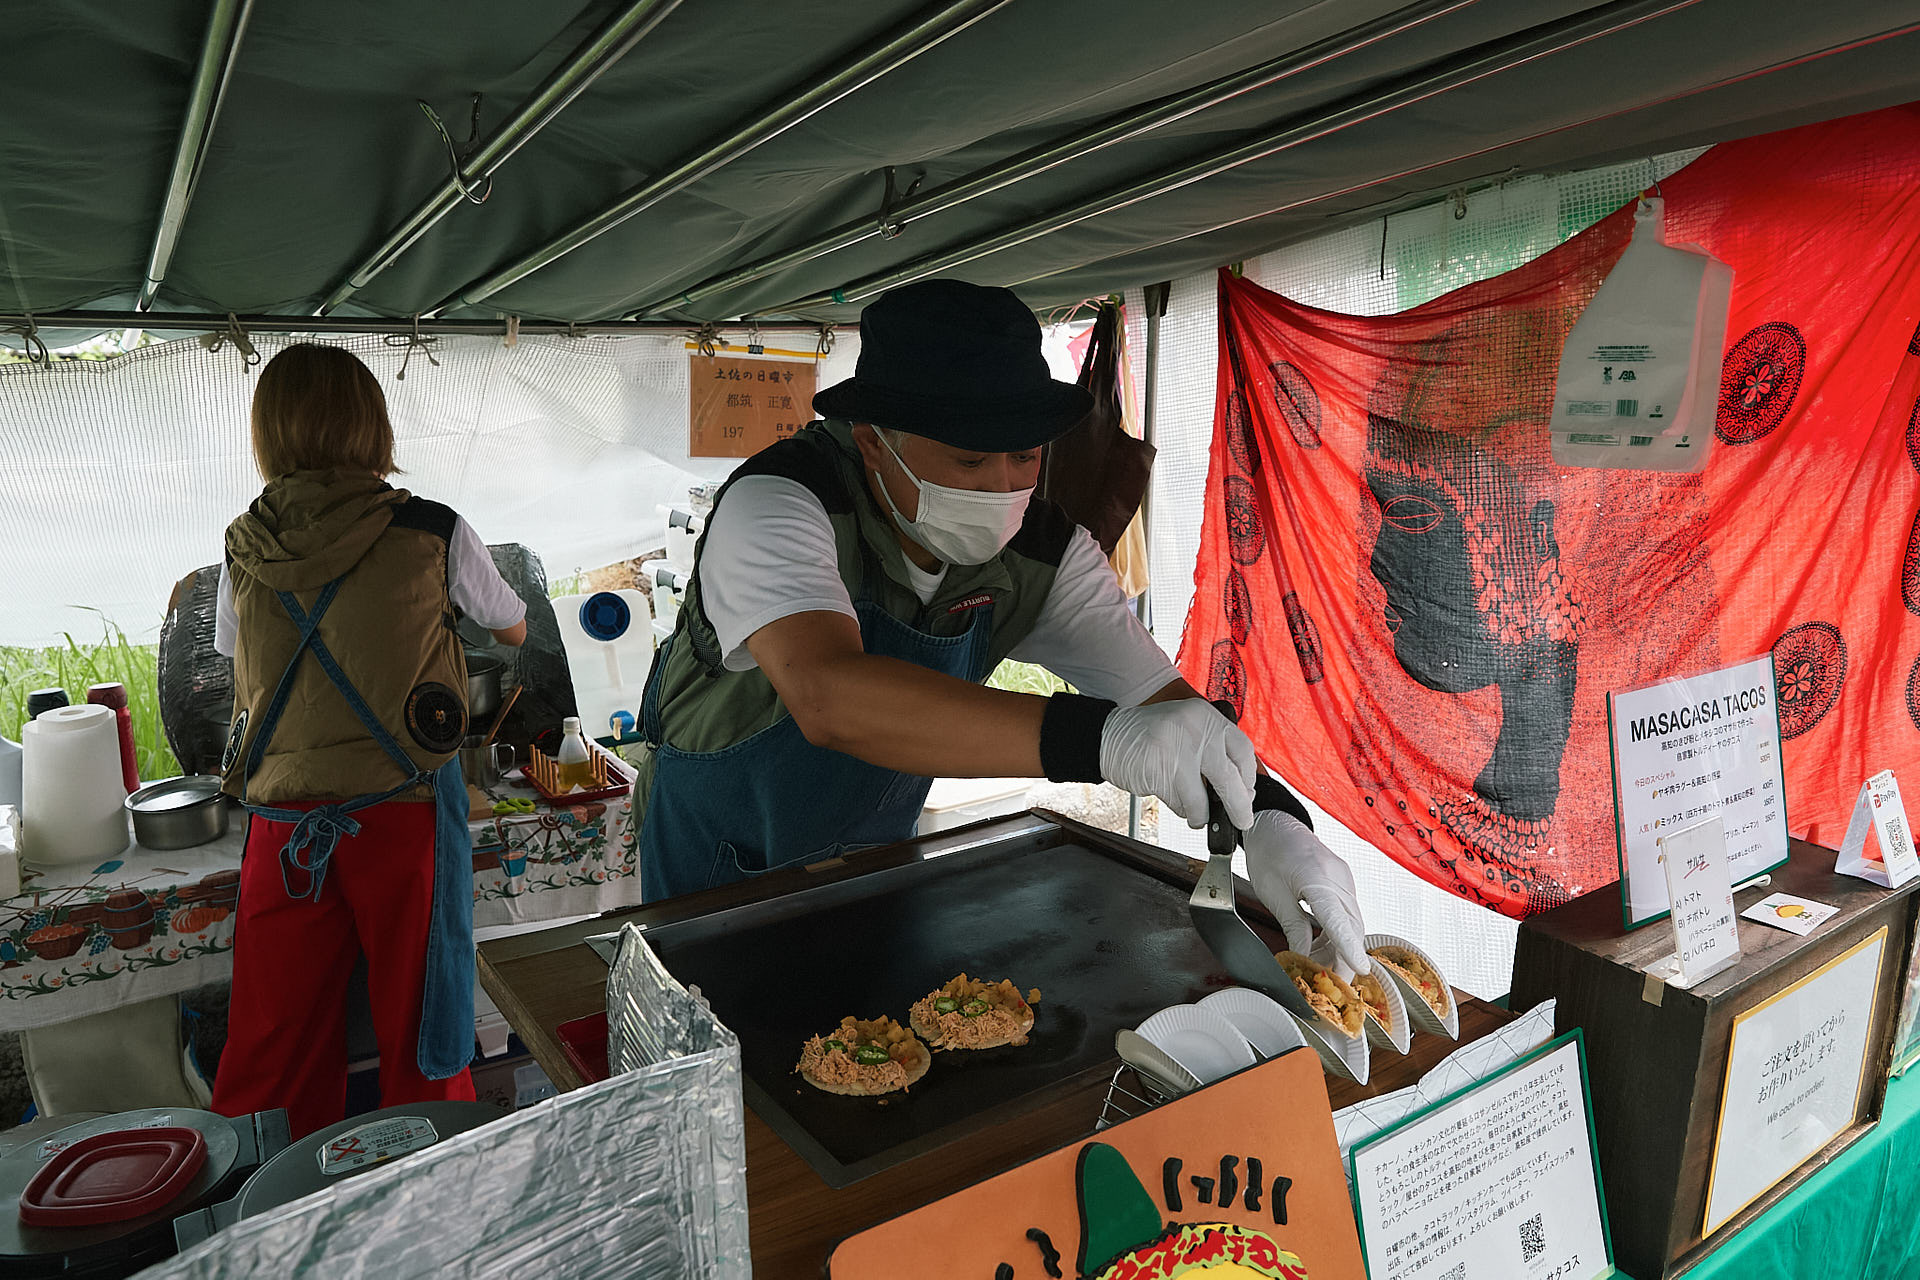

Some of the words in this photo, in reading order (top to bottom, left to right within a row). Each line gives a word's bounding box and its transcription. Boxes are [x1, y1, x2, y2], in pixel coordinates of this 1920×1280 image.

[715, 368, 794, 384] 土佐の日曜市
[728, 393, 753, 408] 都筑
[723, 426, 745, 438] 197
[1630, 700, 1721, 743] MASACASA
[1723, 685, 1767, 716] TACOS
[1634, 770, 1676, 788] 今日のスペシャル
[1687, 854, 1706, 869] サルサ
[1684, 890, 1702, 906] トマト
[1761, 1009, 1847, 1078] ご注文を頂いてから
[1766, 1111, 1778, 1126] We
[1779, 1097, 1796, 1117] cook
[1796, 1092, 1804, 1104] to
